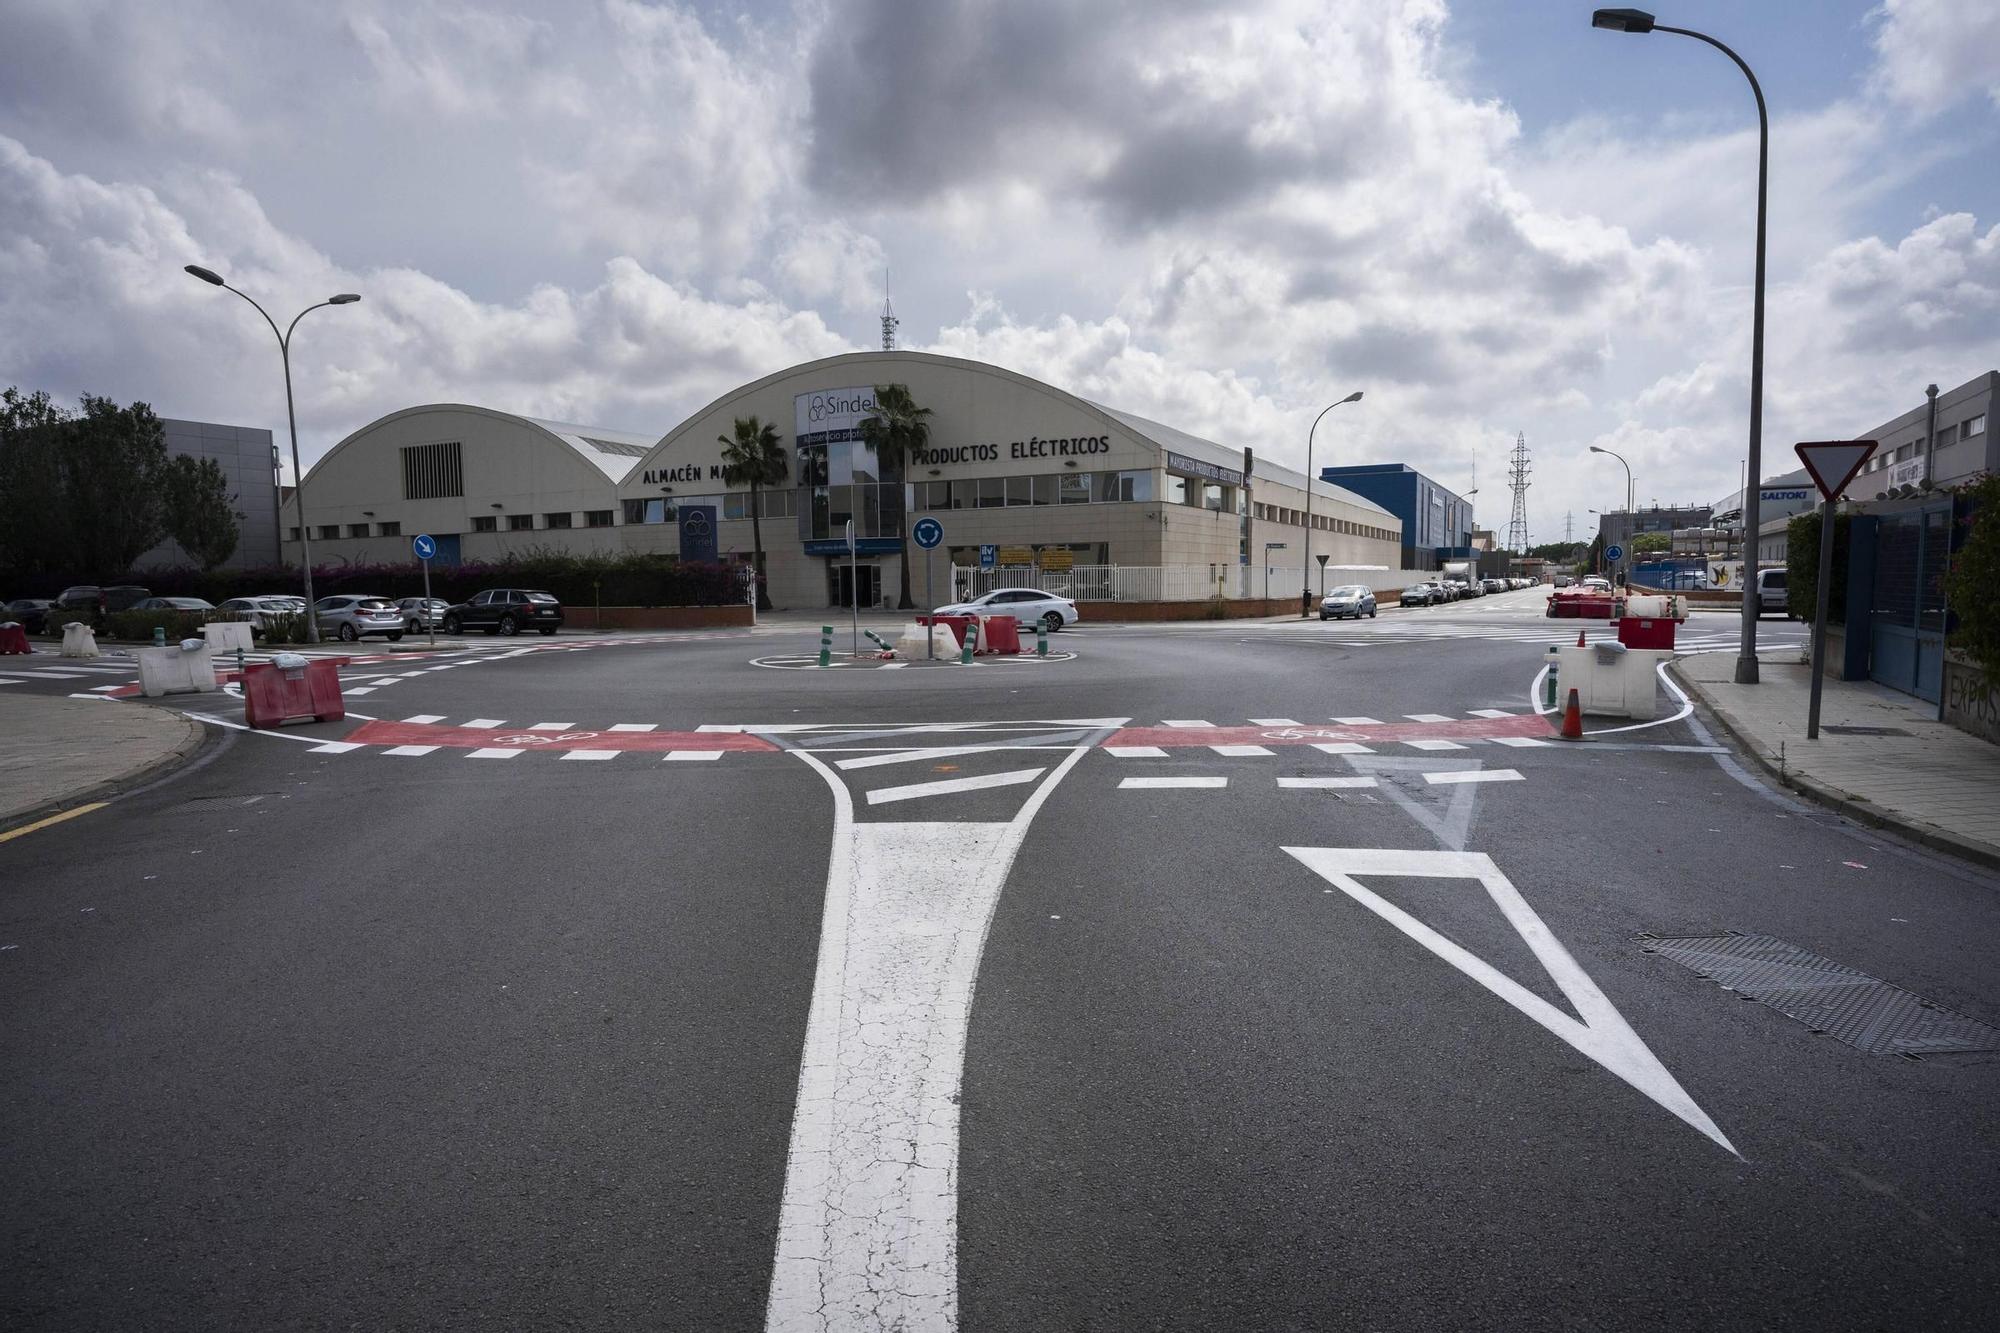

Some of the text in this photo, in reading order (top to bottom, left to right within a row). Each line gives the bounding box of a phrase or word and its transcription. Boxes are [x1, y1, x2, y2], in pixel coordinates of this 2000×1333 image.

[912, 436, 1109, 465] PRODUCTOS ELÉCTRICOS
[643, 464, 701, 484] ALMACÉN
[1761, 491, 1807, 500] SALTOKI
